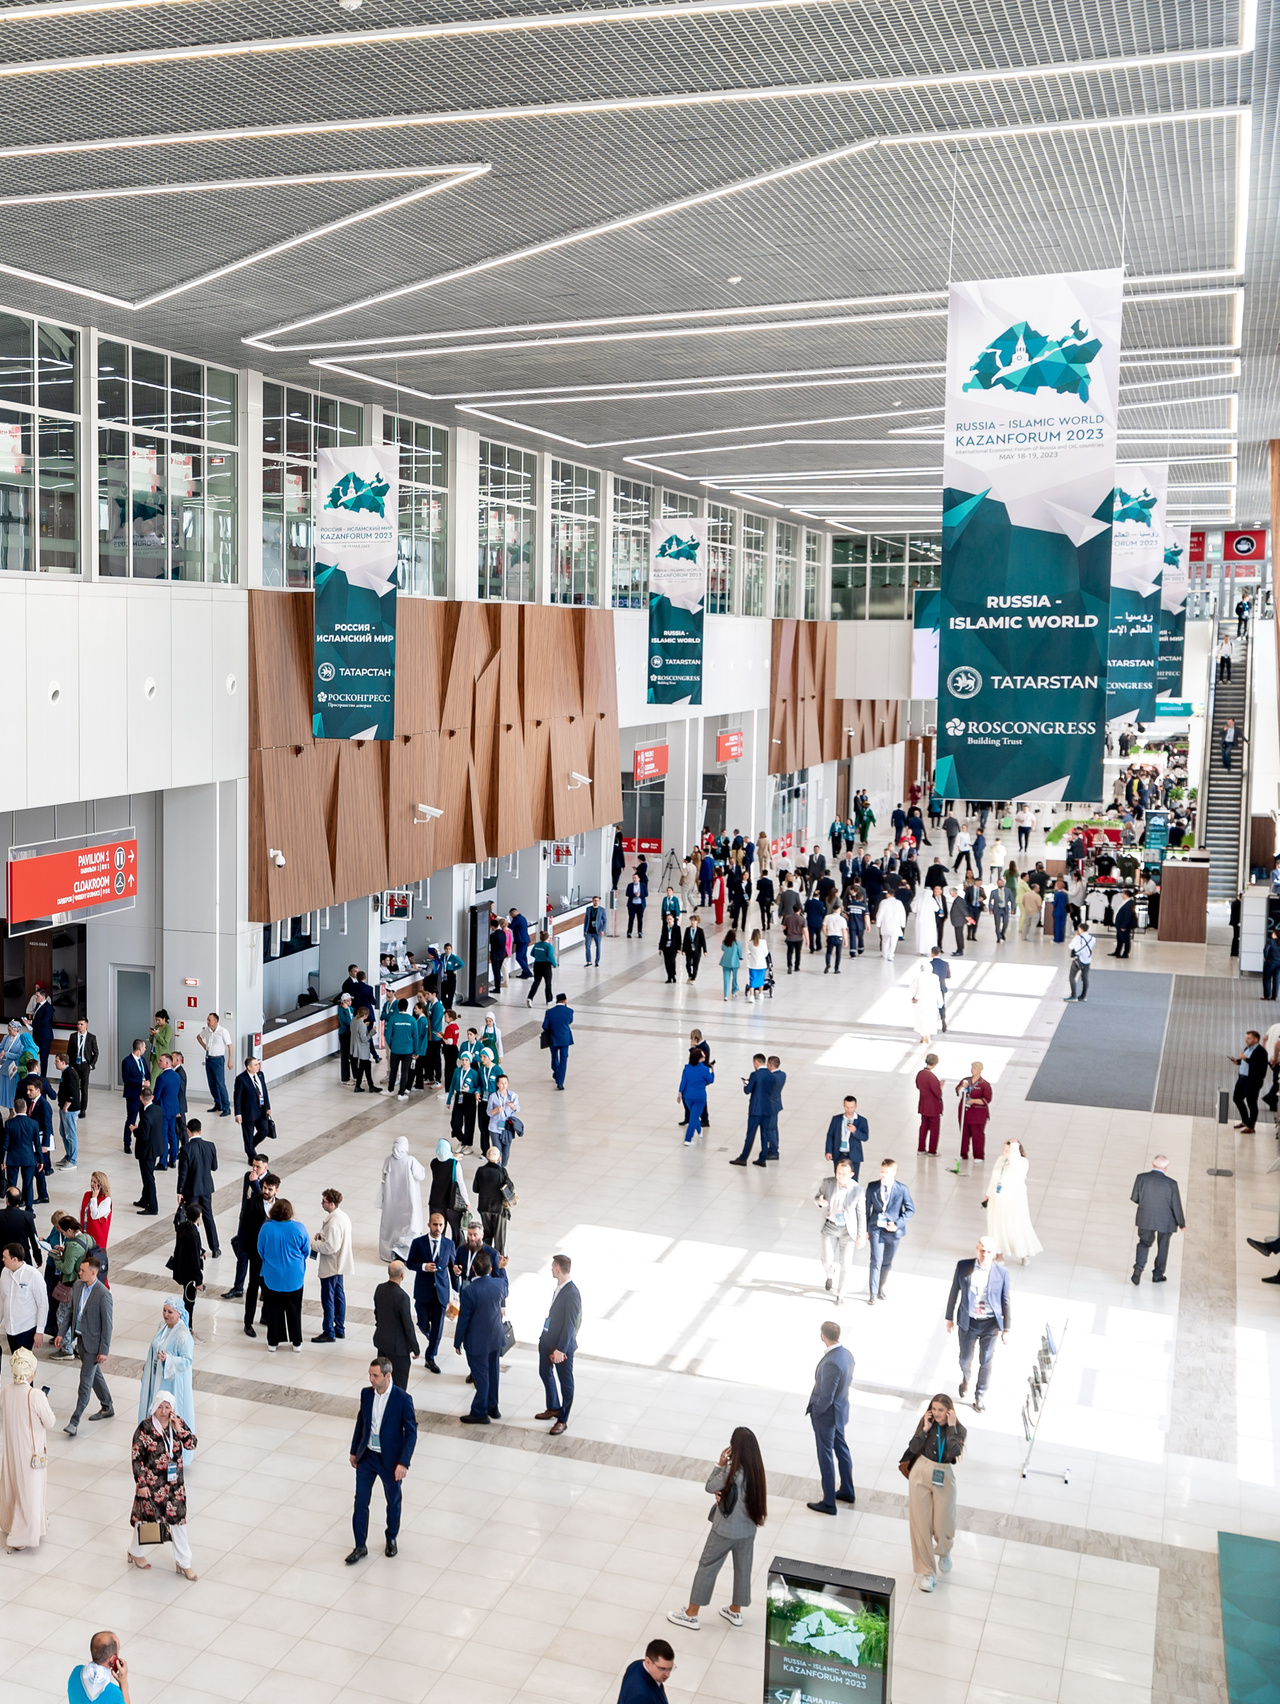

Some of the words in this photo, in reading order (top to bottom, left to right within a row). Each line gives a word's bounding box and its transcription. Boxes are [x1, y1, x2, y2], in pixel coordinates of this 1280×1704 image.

[956, 421, 996, 431] RUSSIA
[1008, 418, 1054, 428] ISLAMIC
[1059, 415, 1104, 425] WORLD
[956, 431, 1061, 447] KAZANFORUM
[1067, 428, 1104, 441] 2023
[986, 595, 1051, 609] RUSSIA
[949, 615, 1022, 630] ISLAMIC
[1026, 614, 1098, 629] WORLD
[1126, 612, 1153, 622] روسيا
[316, 633, 371, 642] ИСЛАМСКИЙ
[1129, 624, 1153, 637] العالم
[339, 668, 391, 676] ТАТАРСТАН
[991, 675, 1098, 689] TATARSTAN
[328, 694, 390, 702] РОСКОНГРЕСС
[967, 721, 1096, 735] ROSCONGRESS
[967, 737, 999, 747] Building
[1001, 737, 1022, 745] Trust
[78, 851, 104, 867] PAVILION
[106, 851, 109, 861] 1
[74, 875, 109, 893] CLOAKROOM
[783, 1657, 807, 1667] RUSSIA
[813, 1663, 840, 1675] ISLAMIC
[841, 1670, 867, 1680] WORLD
[783, 1664, 843, 1684] KAZANFORUM
[845, 1679, 867, 1689] 2023
